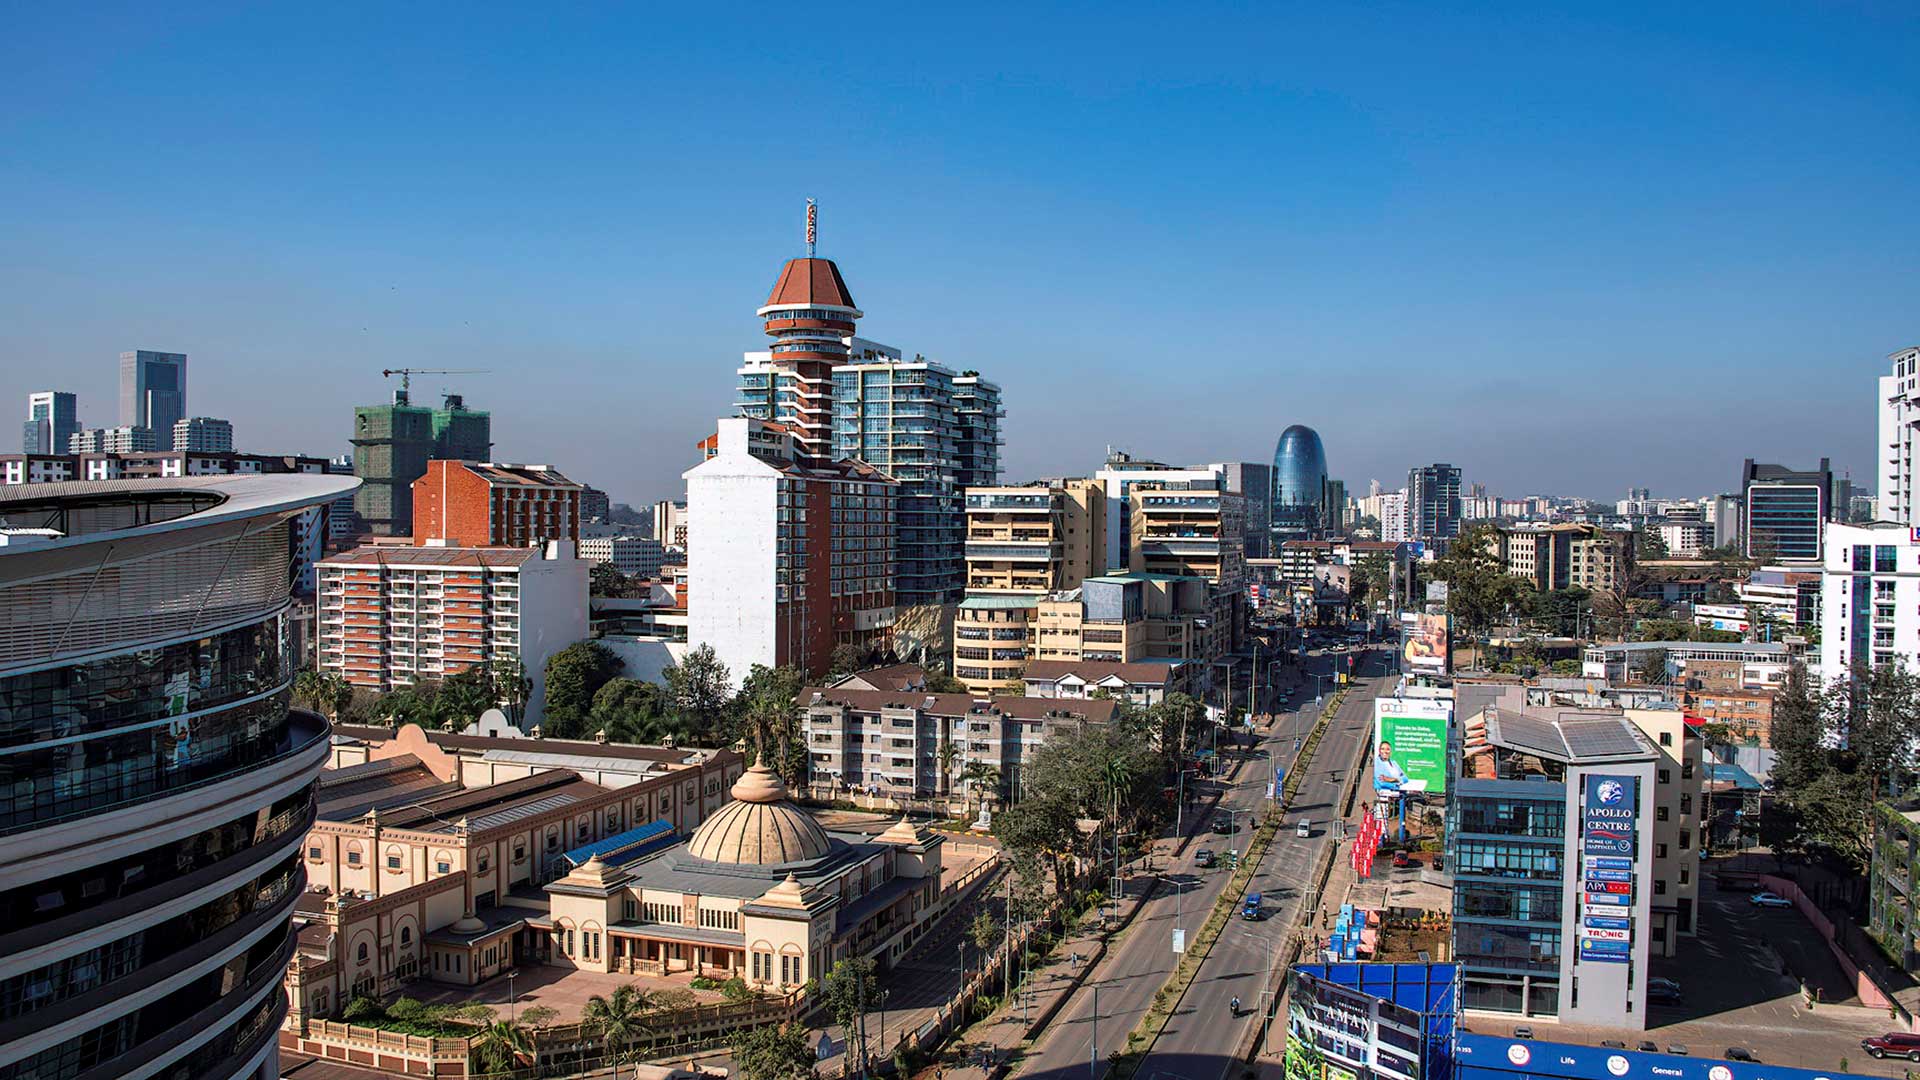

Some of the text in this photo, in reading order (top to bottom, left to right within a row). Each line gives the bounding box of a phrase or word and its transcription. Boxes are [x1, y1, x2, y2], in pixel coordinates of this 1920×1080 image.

[1587, 808, 1632, 818] APOLLO
[1587, 821, 1631, 831] CENTRE
[1586, 882, 1607, 891] APA
[1587, 929, 1624, 938] TRONIC
[1560, 1056, 1576, 1065] Life
[1651, 1066, 1683, 1077] General
